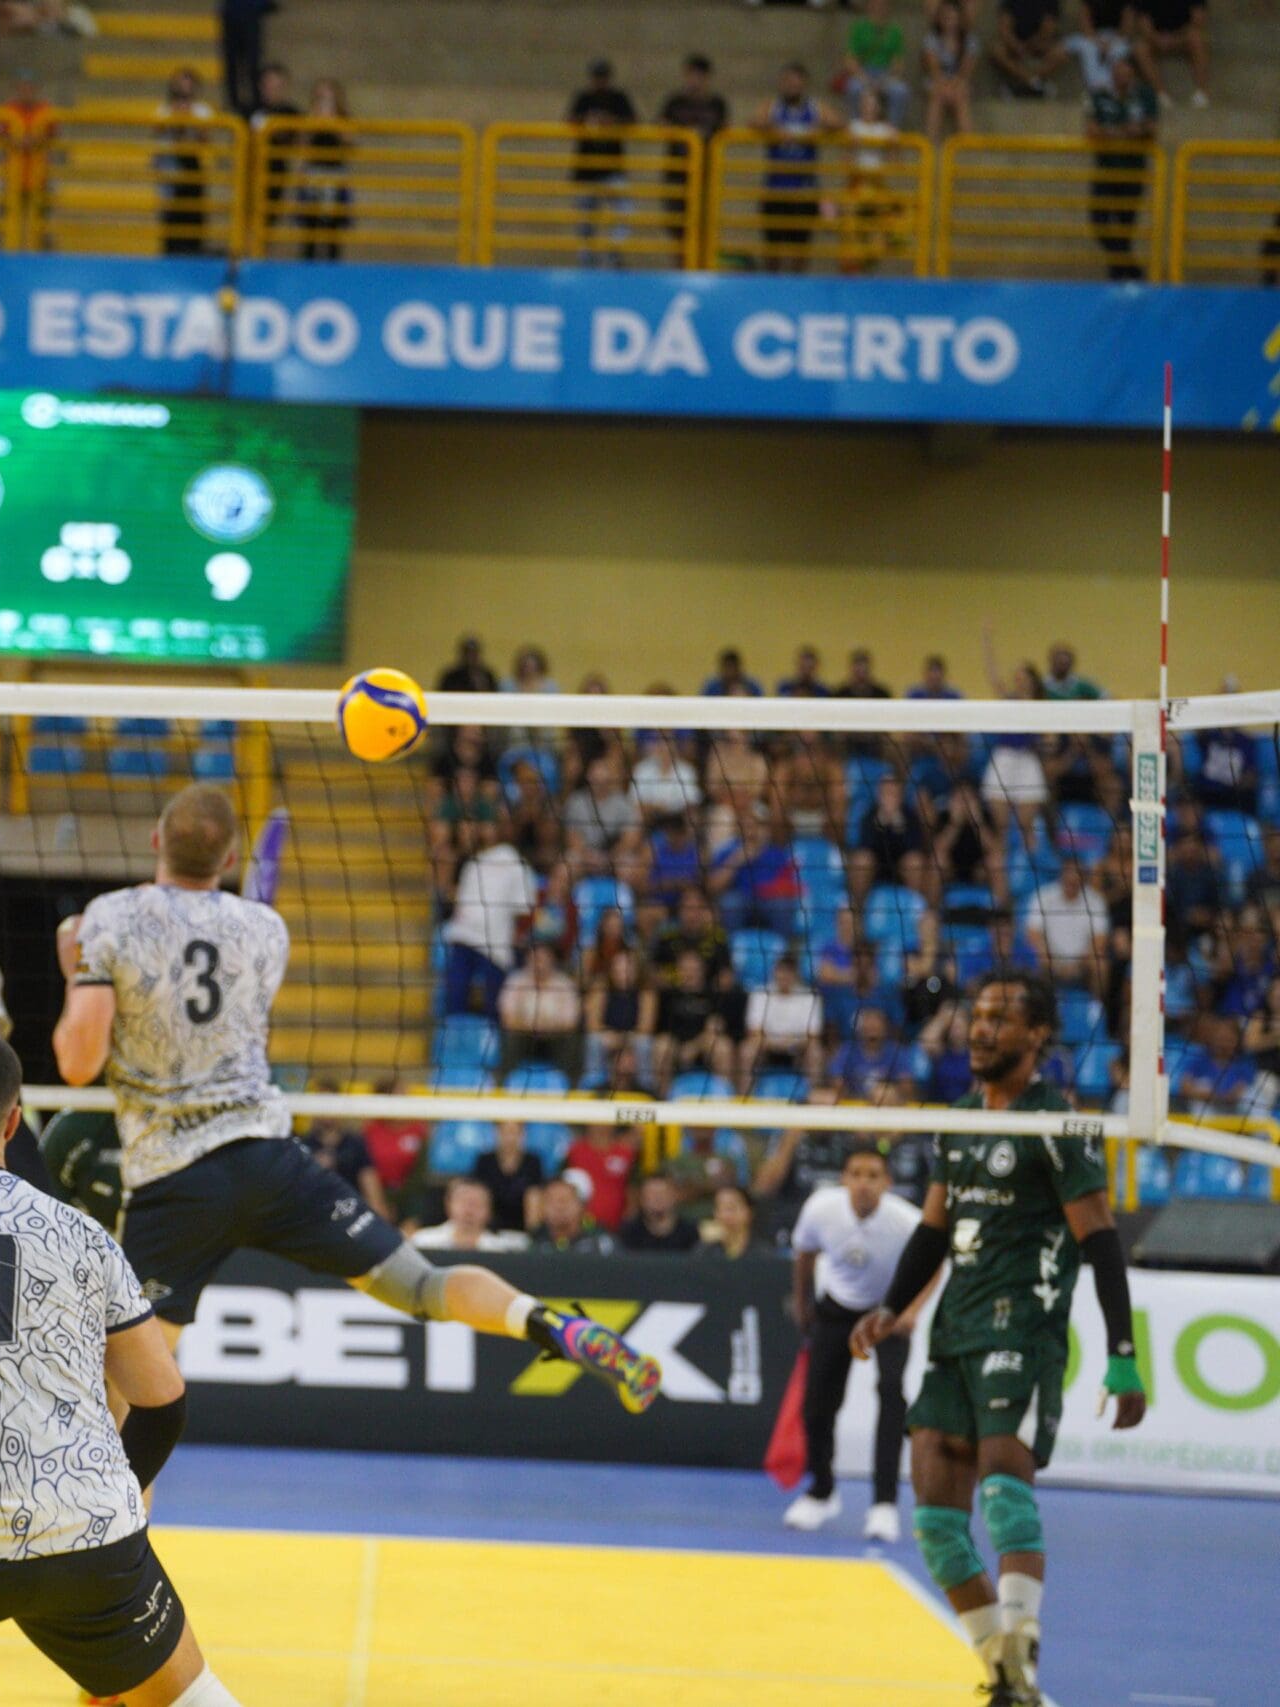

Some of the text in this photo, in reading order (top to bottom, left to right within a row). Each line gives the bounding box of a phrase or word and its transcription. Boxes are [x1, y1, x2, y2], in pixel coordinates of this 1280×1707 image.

[29, 291, 359, 365] ESTADO
[382, 299, 564, 374] QUE
[590, 293, 710, 376] DÁ
[732, 312, 1019, 385] CERTO
[182, 940, 223, 1025] 3
